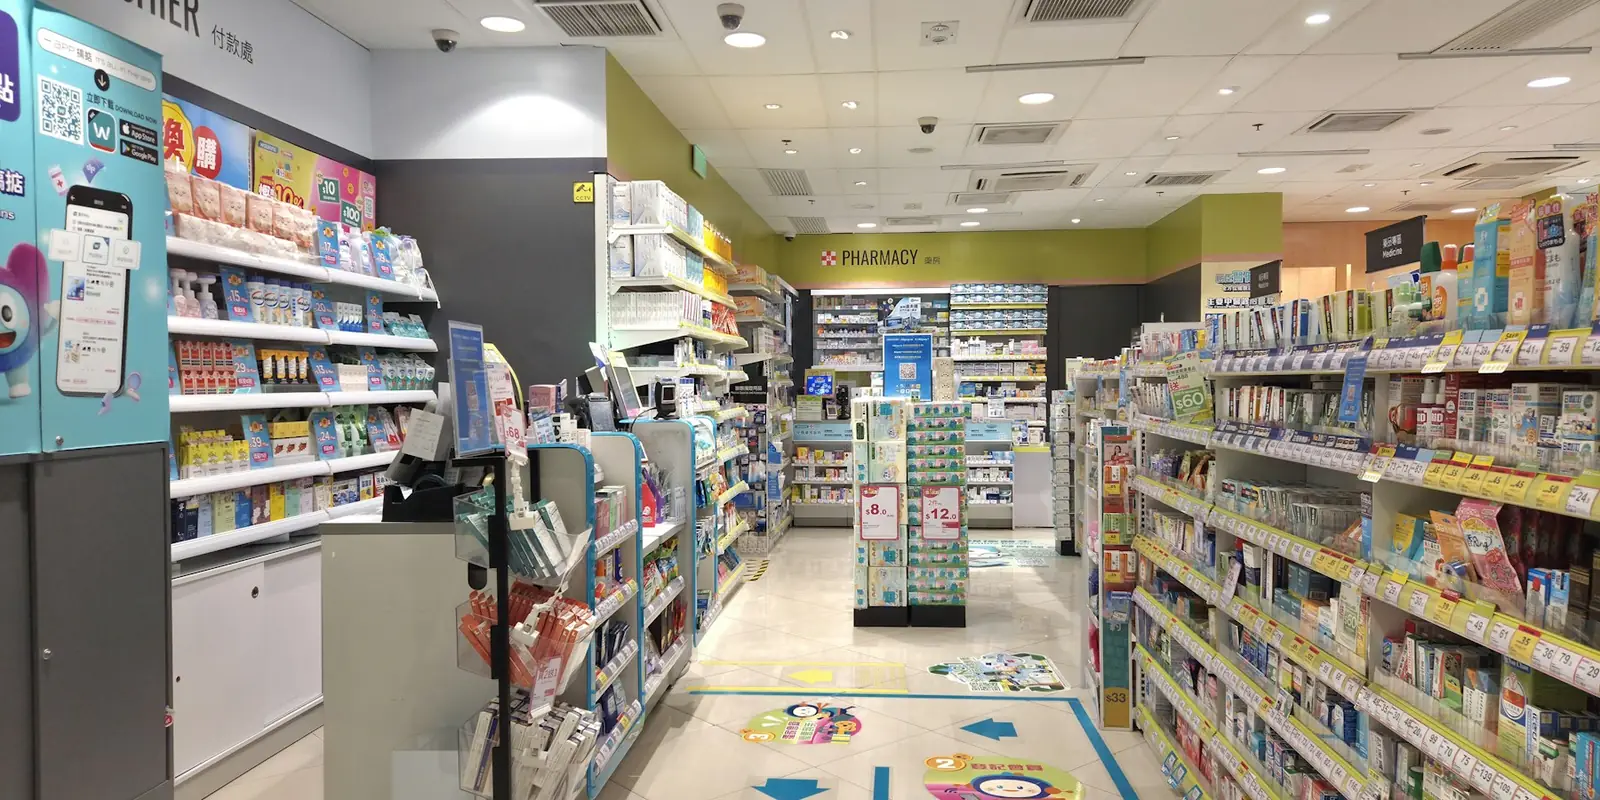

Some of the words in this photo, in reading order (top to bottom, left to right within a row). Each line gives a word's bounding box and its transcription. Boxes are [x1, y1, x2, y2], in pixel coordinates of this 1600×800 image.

[211, 24, 254, 64] 付款處
[86, 92, 115, 112] 立即下載
[115, 106, 145, 121] DOWNLOAD
[145, 116, 158, 125] NOW
[131, 129, 142, 140] App
[141, 133, 156, 144] Store
[131, 148, 147, 160] Google
[147, 152, 157, 164] Play
[196, 136, 217, 171] 購
[322, 180, 335, 195] $10
[0, 210, 15, 221] ns
[343, 206, 360, 222] $100
[842, 249, 918, 266] PHARMACY
[1382, 247, 1403, 259] Medicine
[234, 363, 247, 373] 29
[1176, 392, 1204, 409] $60
[251, 436, 262, 448] 39
[865, 503, 887, 516] $8.0
[926, 508, 957, 520] $12.0
[1474, 620, 1484, 631] 49
[1499, 628, 1508, 639] 61
[1520, 635, 1530, 646] 35
[1542, 647, 1553, 660] 36
[1587, 665, 1600, 678] 29
[1106, 692, 1126, 703] $33
[1429, 733, 1438, 744] 99
[1444, 745, 1453, 757] 70
[935, 758, 956, 769] 2
[1461, 754, 1471, 766] 75
[1479, 767, 1493, 782] 139
